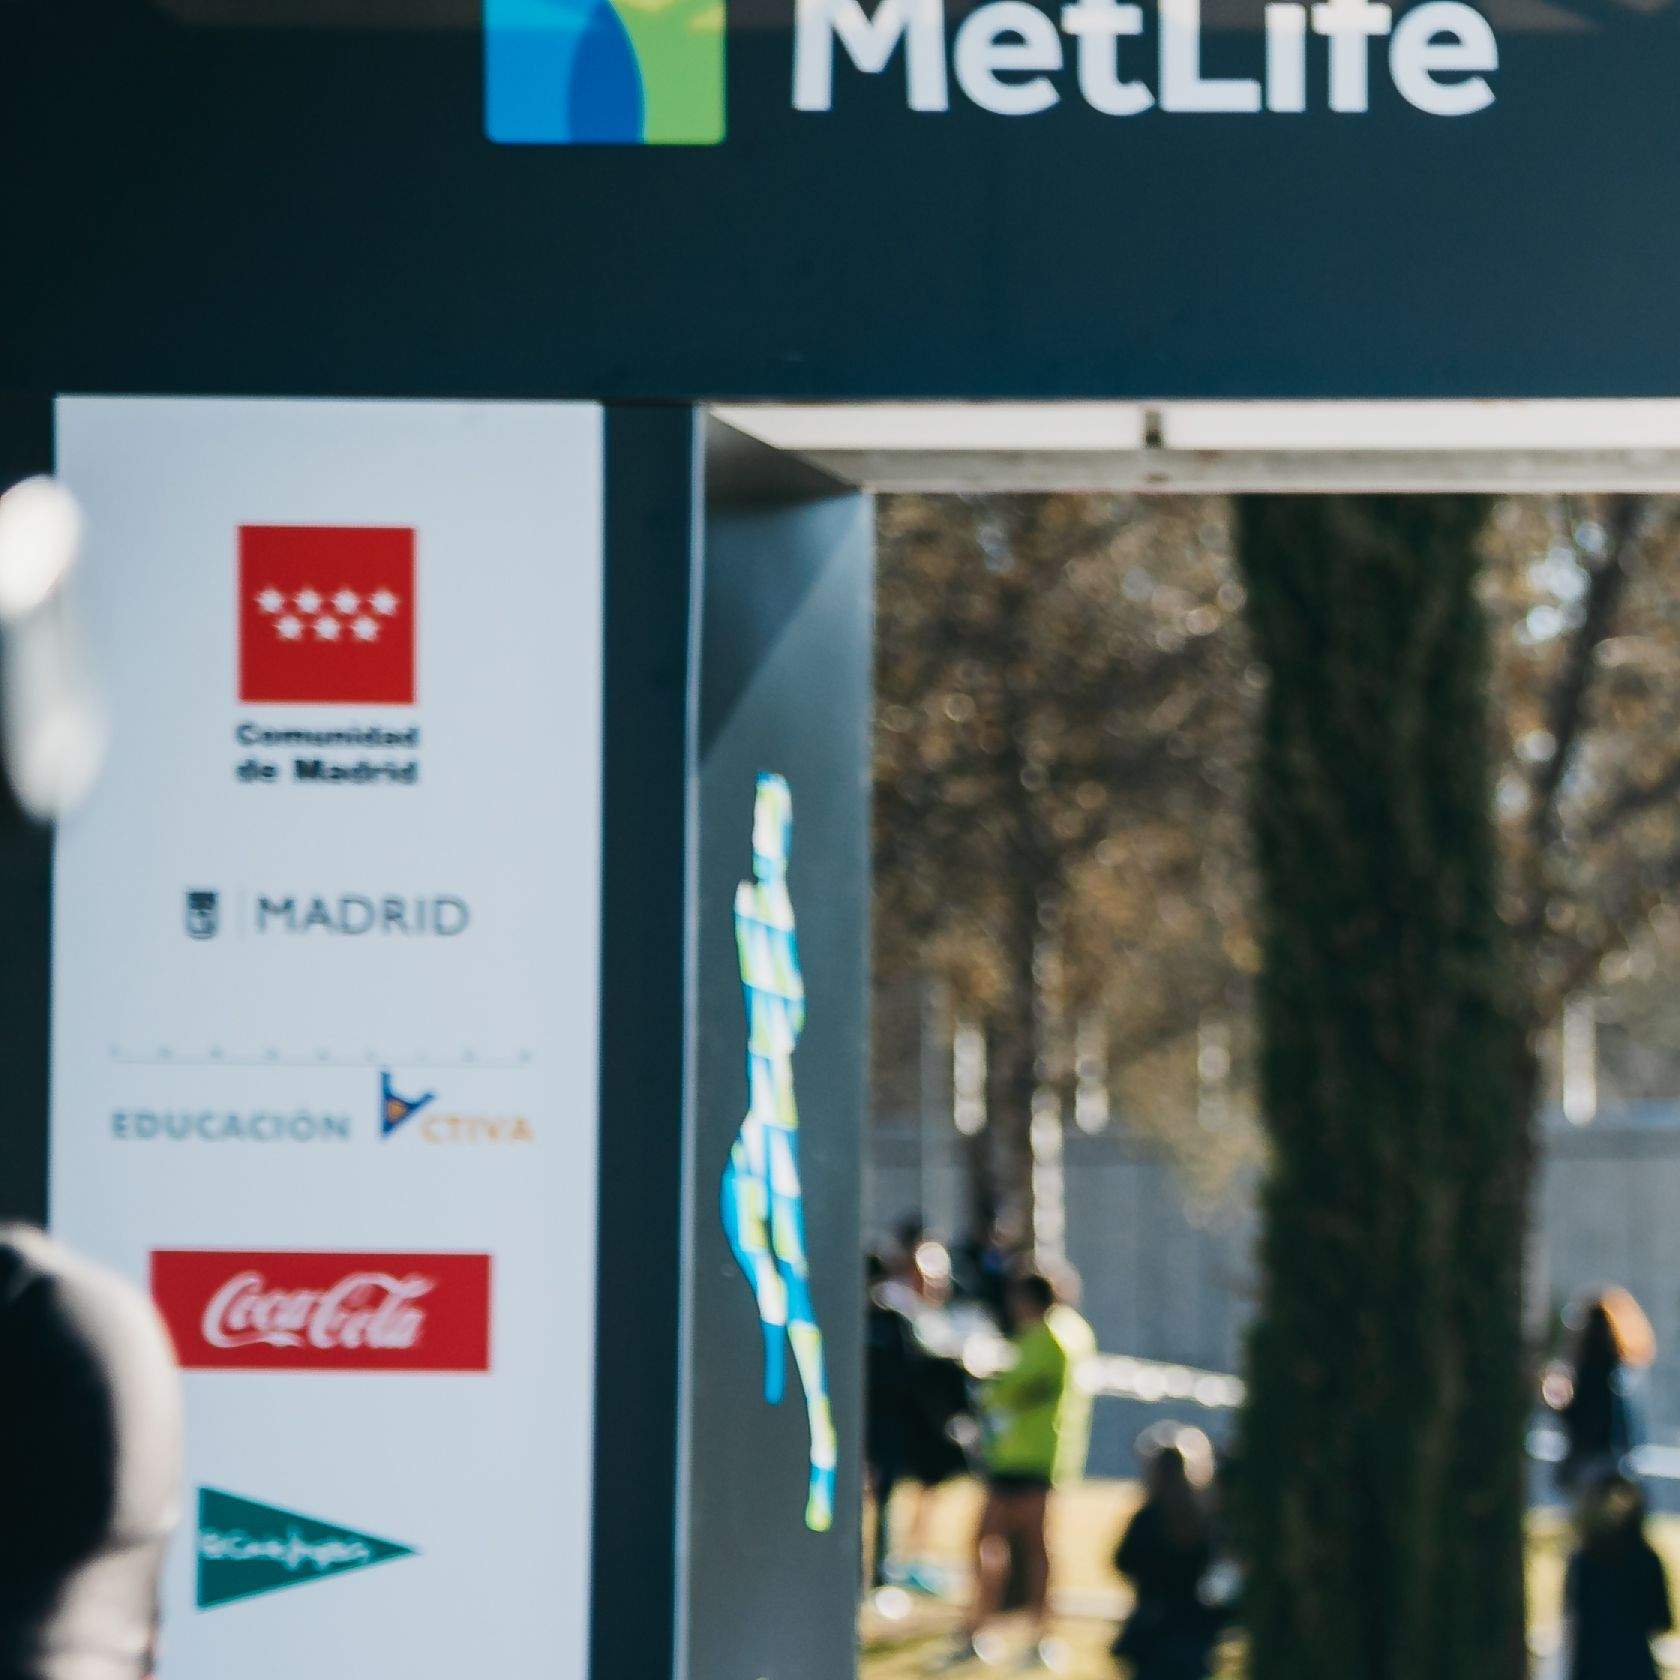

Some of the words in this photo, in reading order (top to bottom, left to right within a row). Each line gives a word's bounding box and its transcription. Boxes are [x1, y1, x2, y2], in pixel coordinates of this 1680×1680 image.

[790, 0, 1500, 115] MetLife
[235, 723, 420, 748] Comunidad
[235, 759, 277, 783] de
[294, 758, 420, 785] Madrid
[256, 896, 470, 937] MADRID
